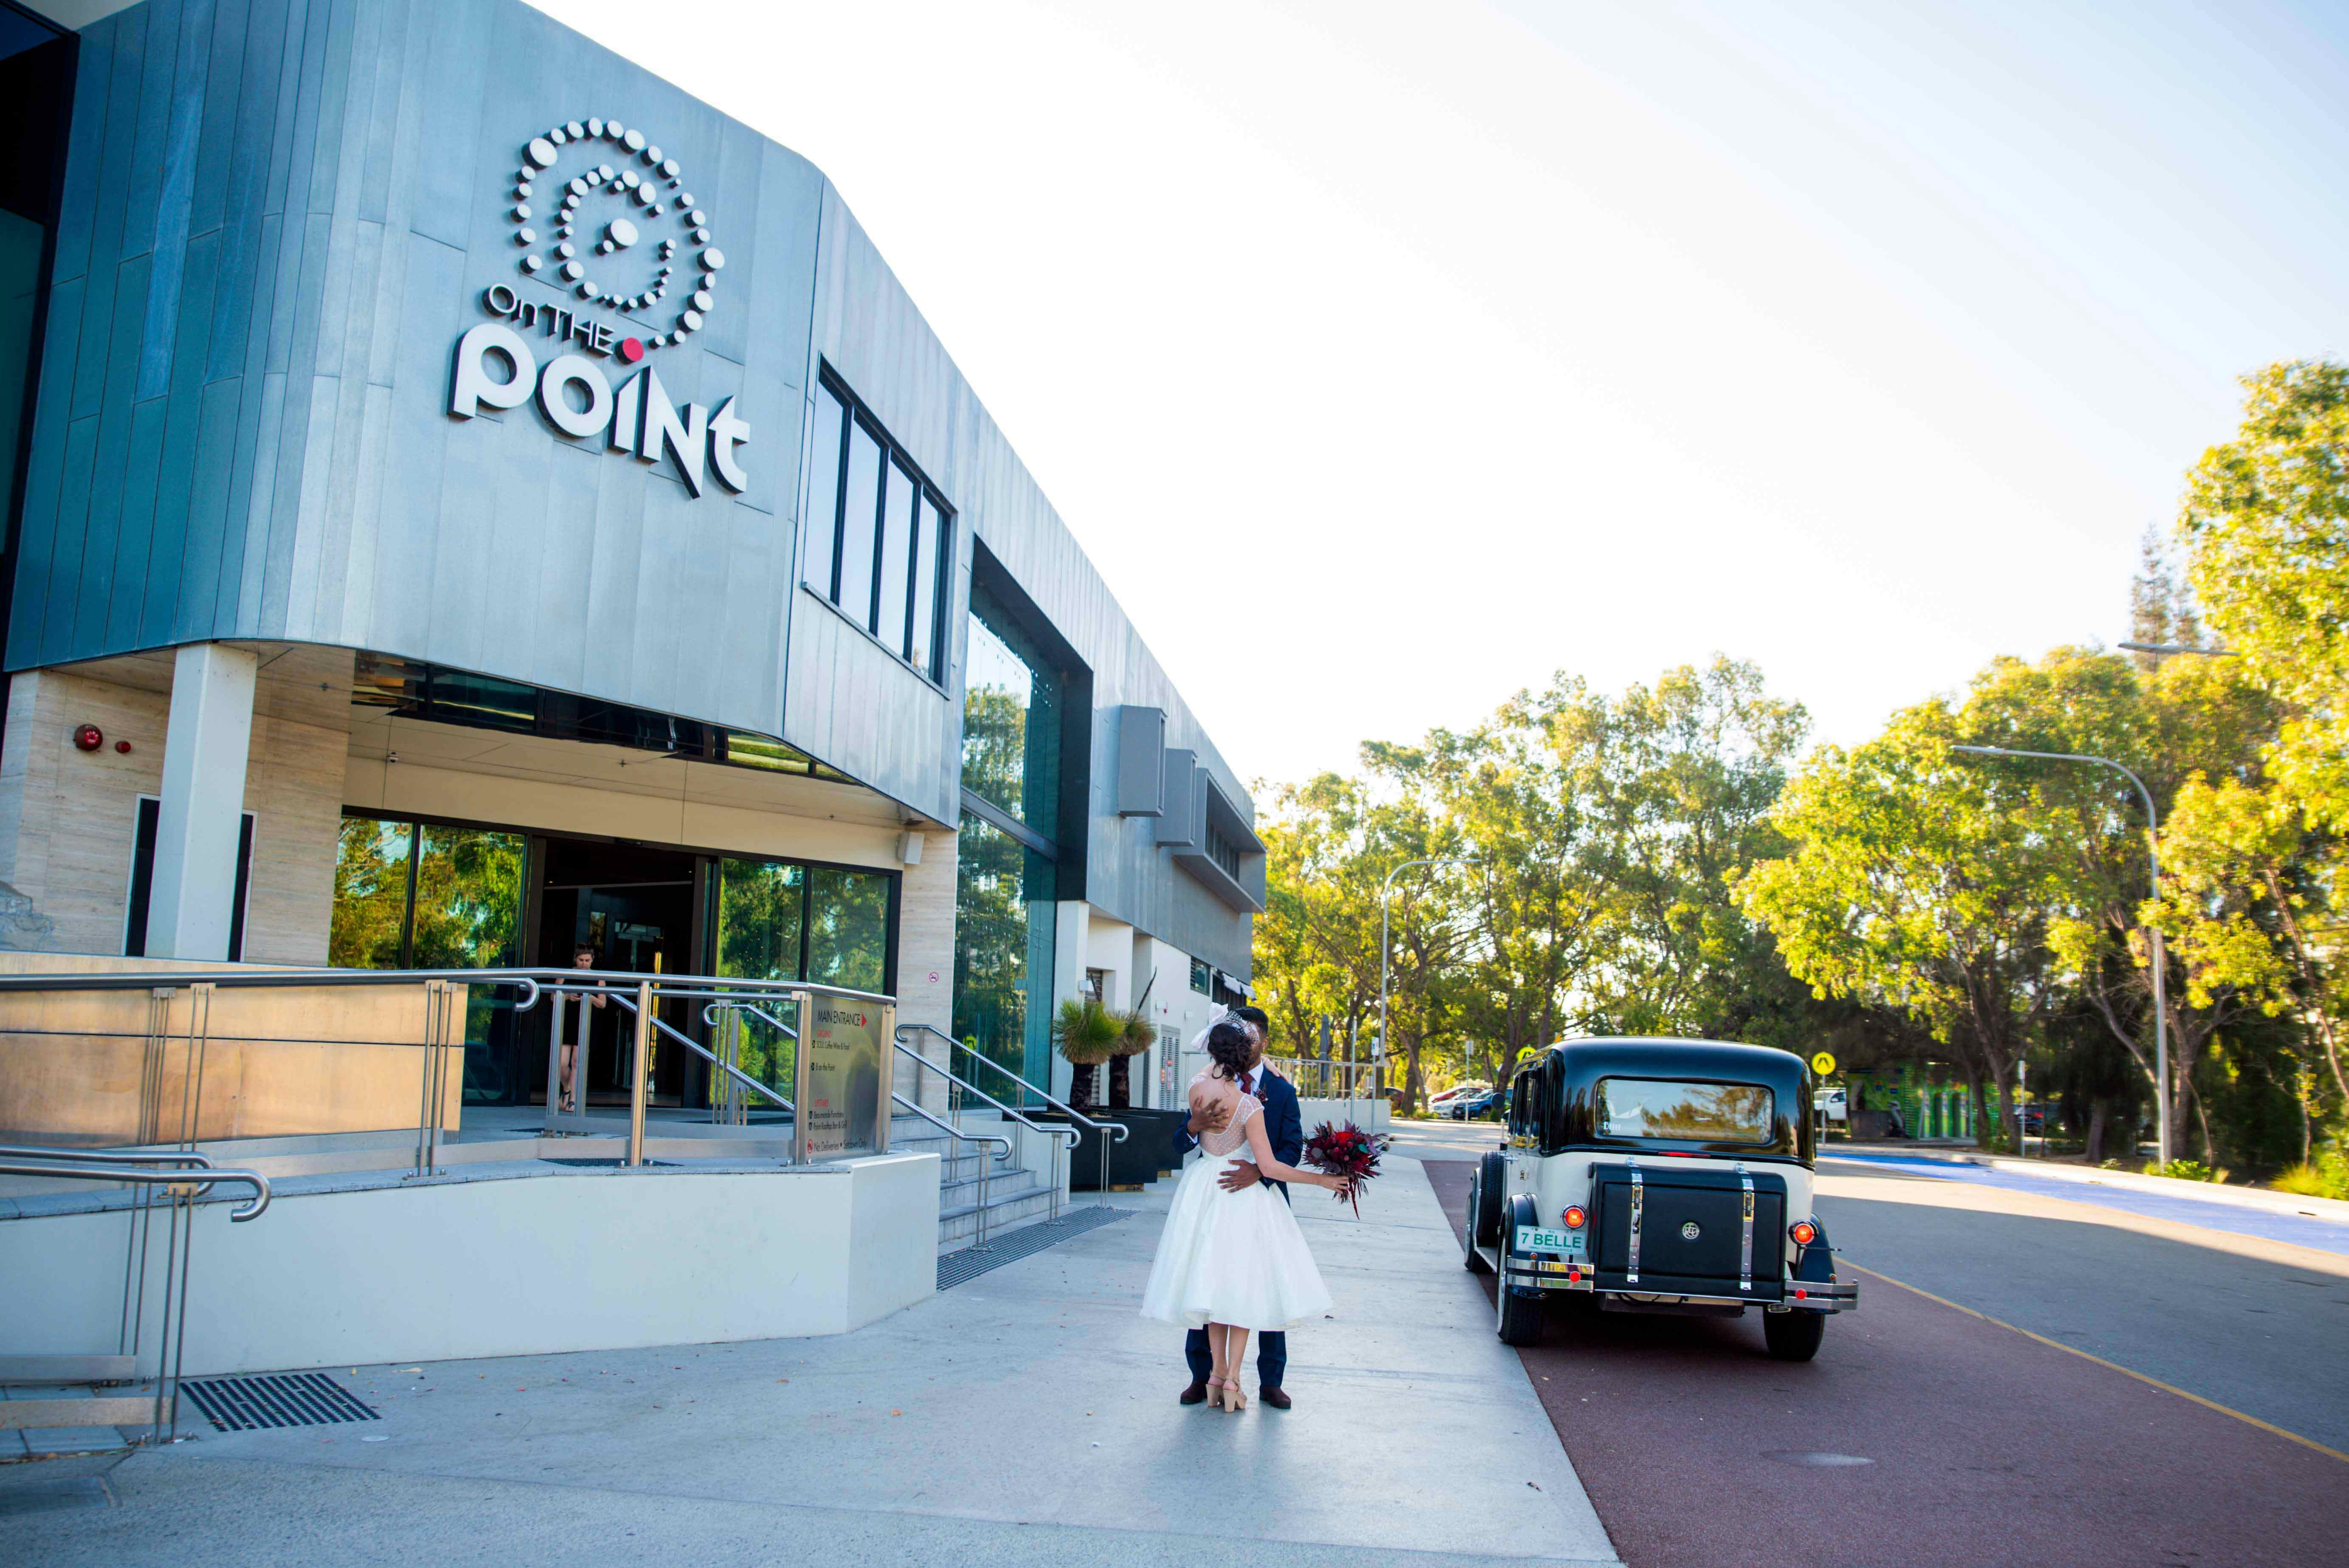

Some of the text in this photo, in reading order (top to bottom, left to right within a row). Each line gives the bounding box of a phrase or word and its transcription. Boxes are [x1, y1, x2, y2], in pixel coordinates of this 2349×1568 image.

[540, 302, 615, 357] THE
[817, 1009, 860, 1026] MAIN ENTRANCE
[814, 1142, 820, 1152] No
[821, 1139, 839, 1151] Deliveries
[1522, 1232, 1582, 1248] 7 BELLE
